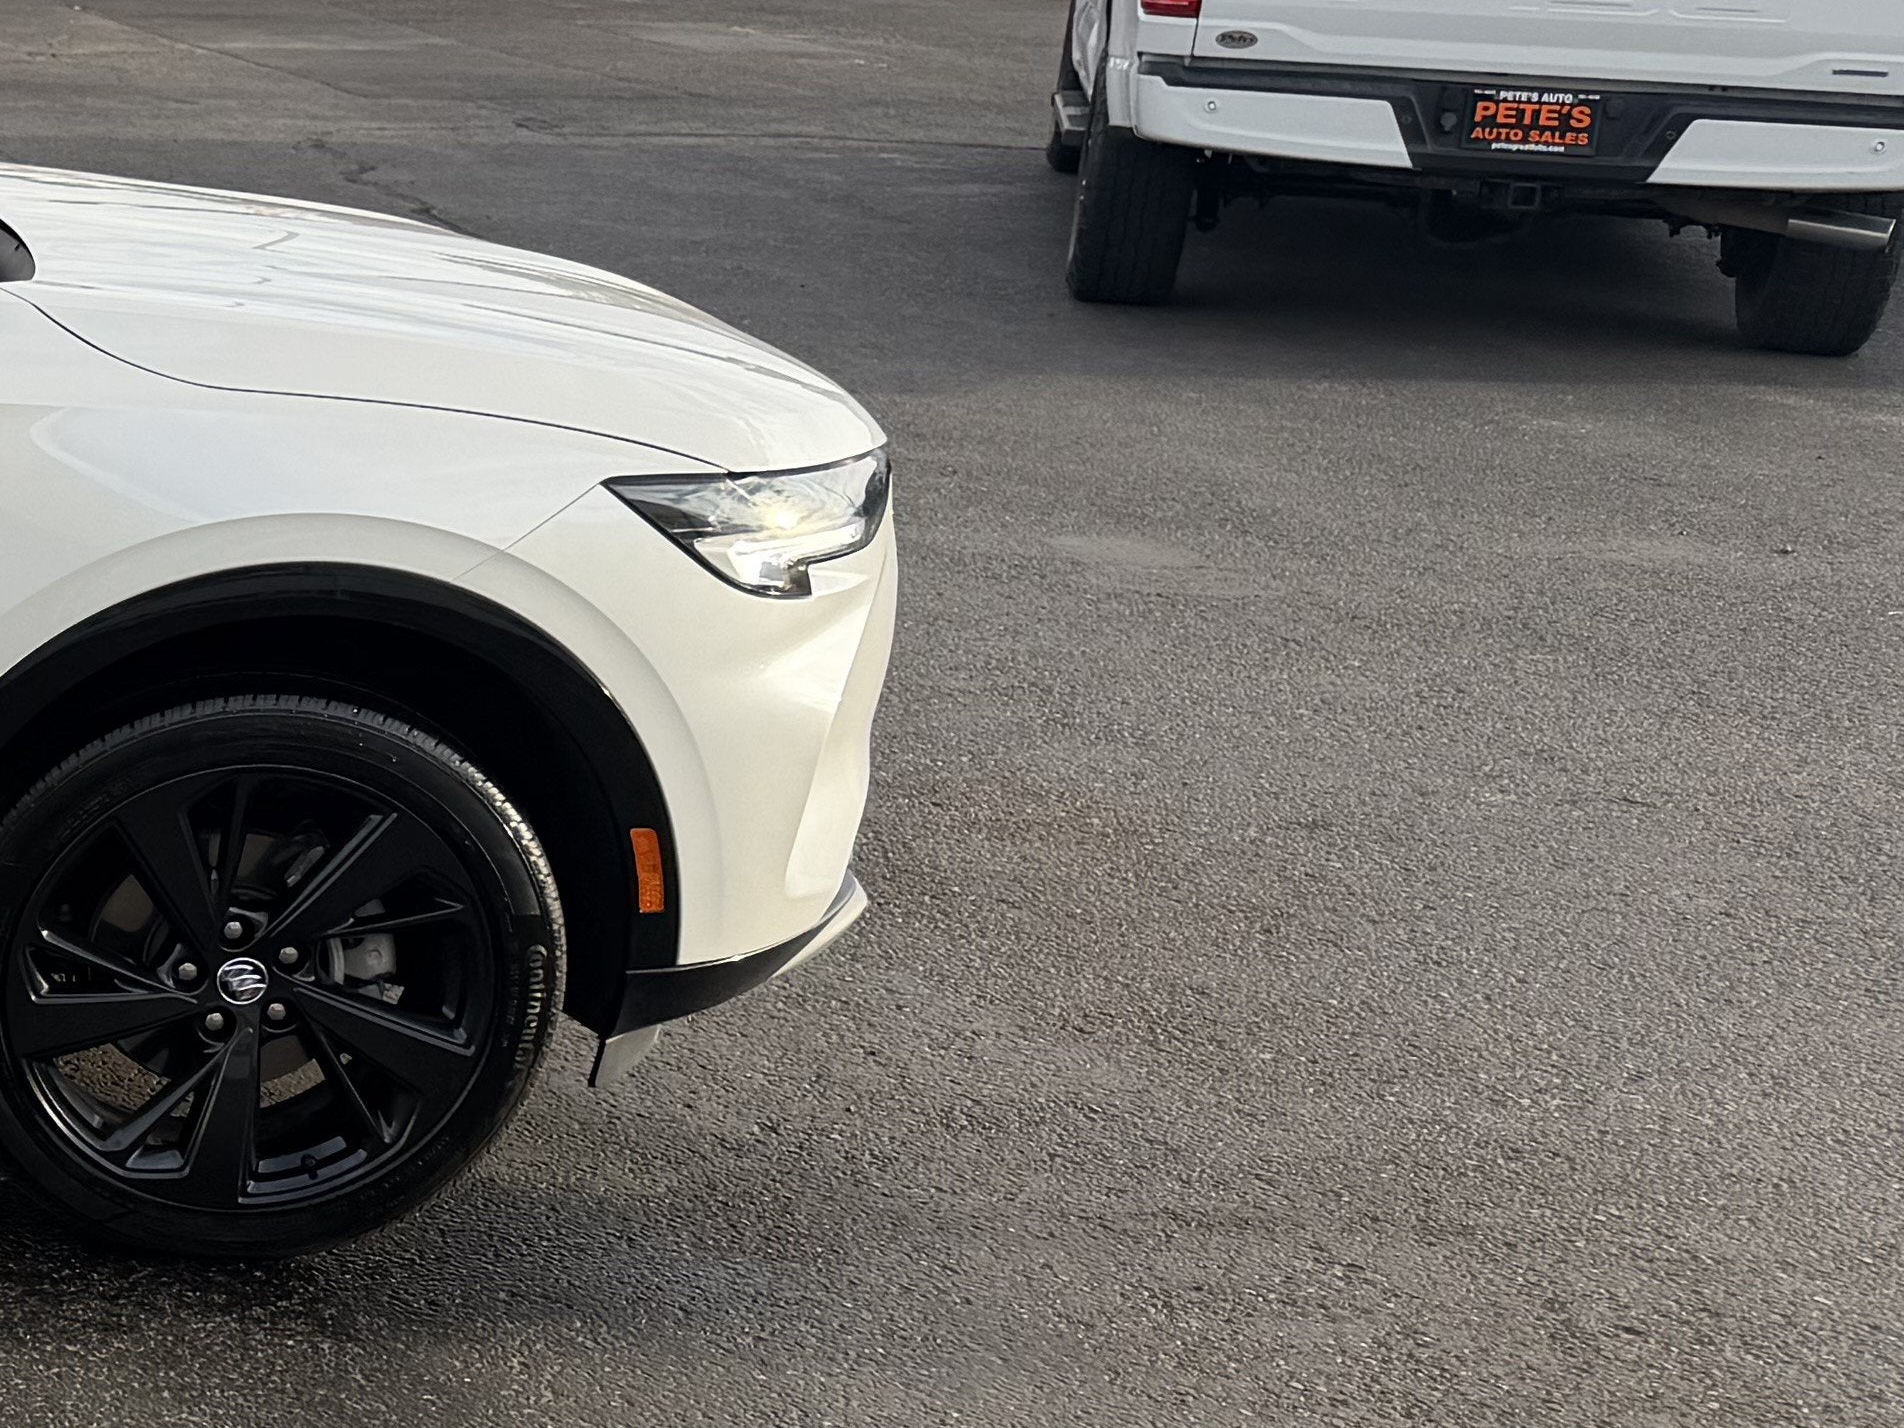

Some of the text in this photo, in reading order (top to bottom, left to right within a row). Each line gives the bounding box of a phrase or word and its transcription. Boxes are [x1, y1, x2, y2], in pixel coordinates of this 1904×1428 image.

[1499, 90, 1539, 102] PETE'S
[1541, 92, 1574, 104] AUTO
[1473, 101, 1592, 129] PETE'S
[1470, 127, 1589, 146] AUTO SALES
